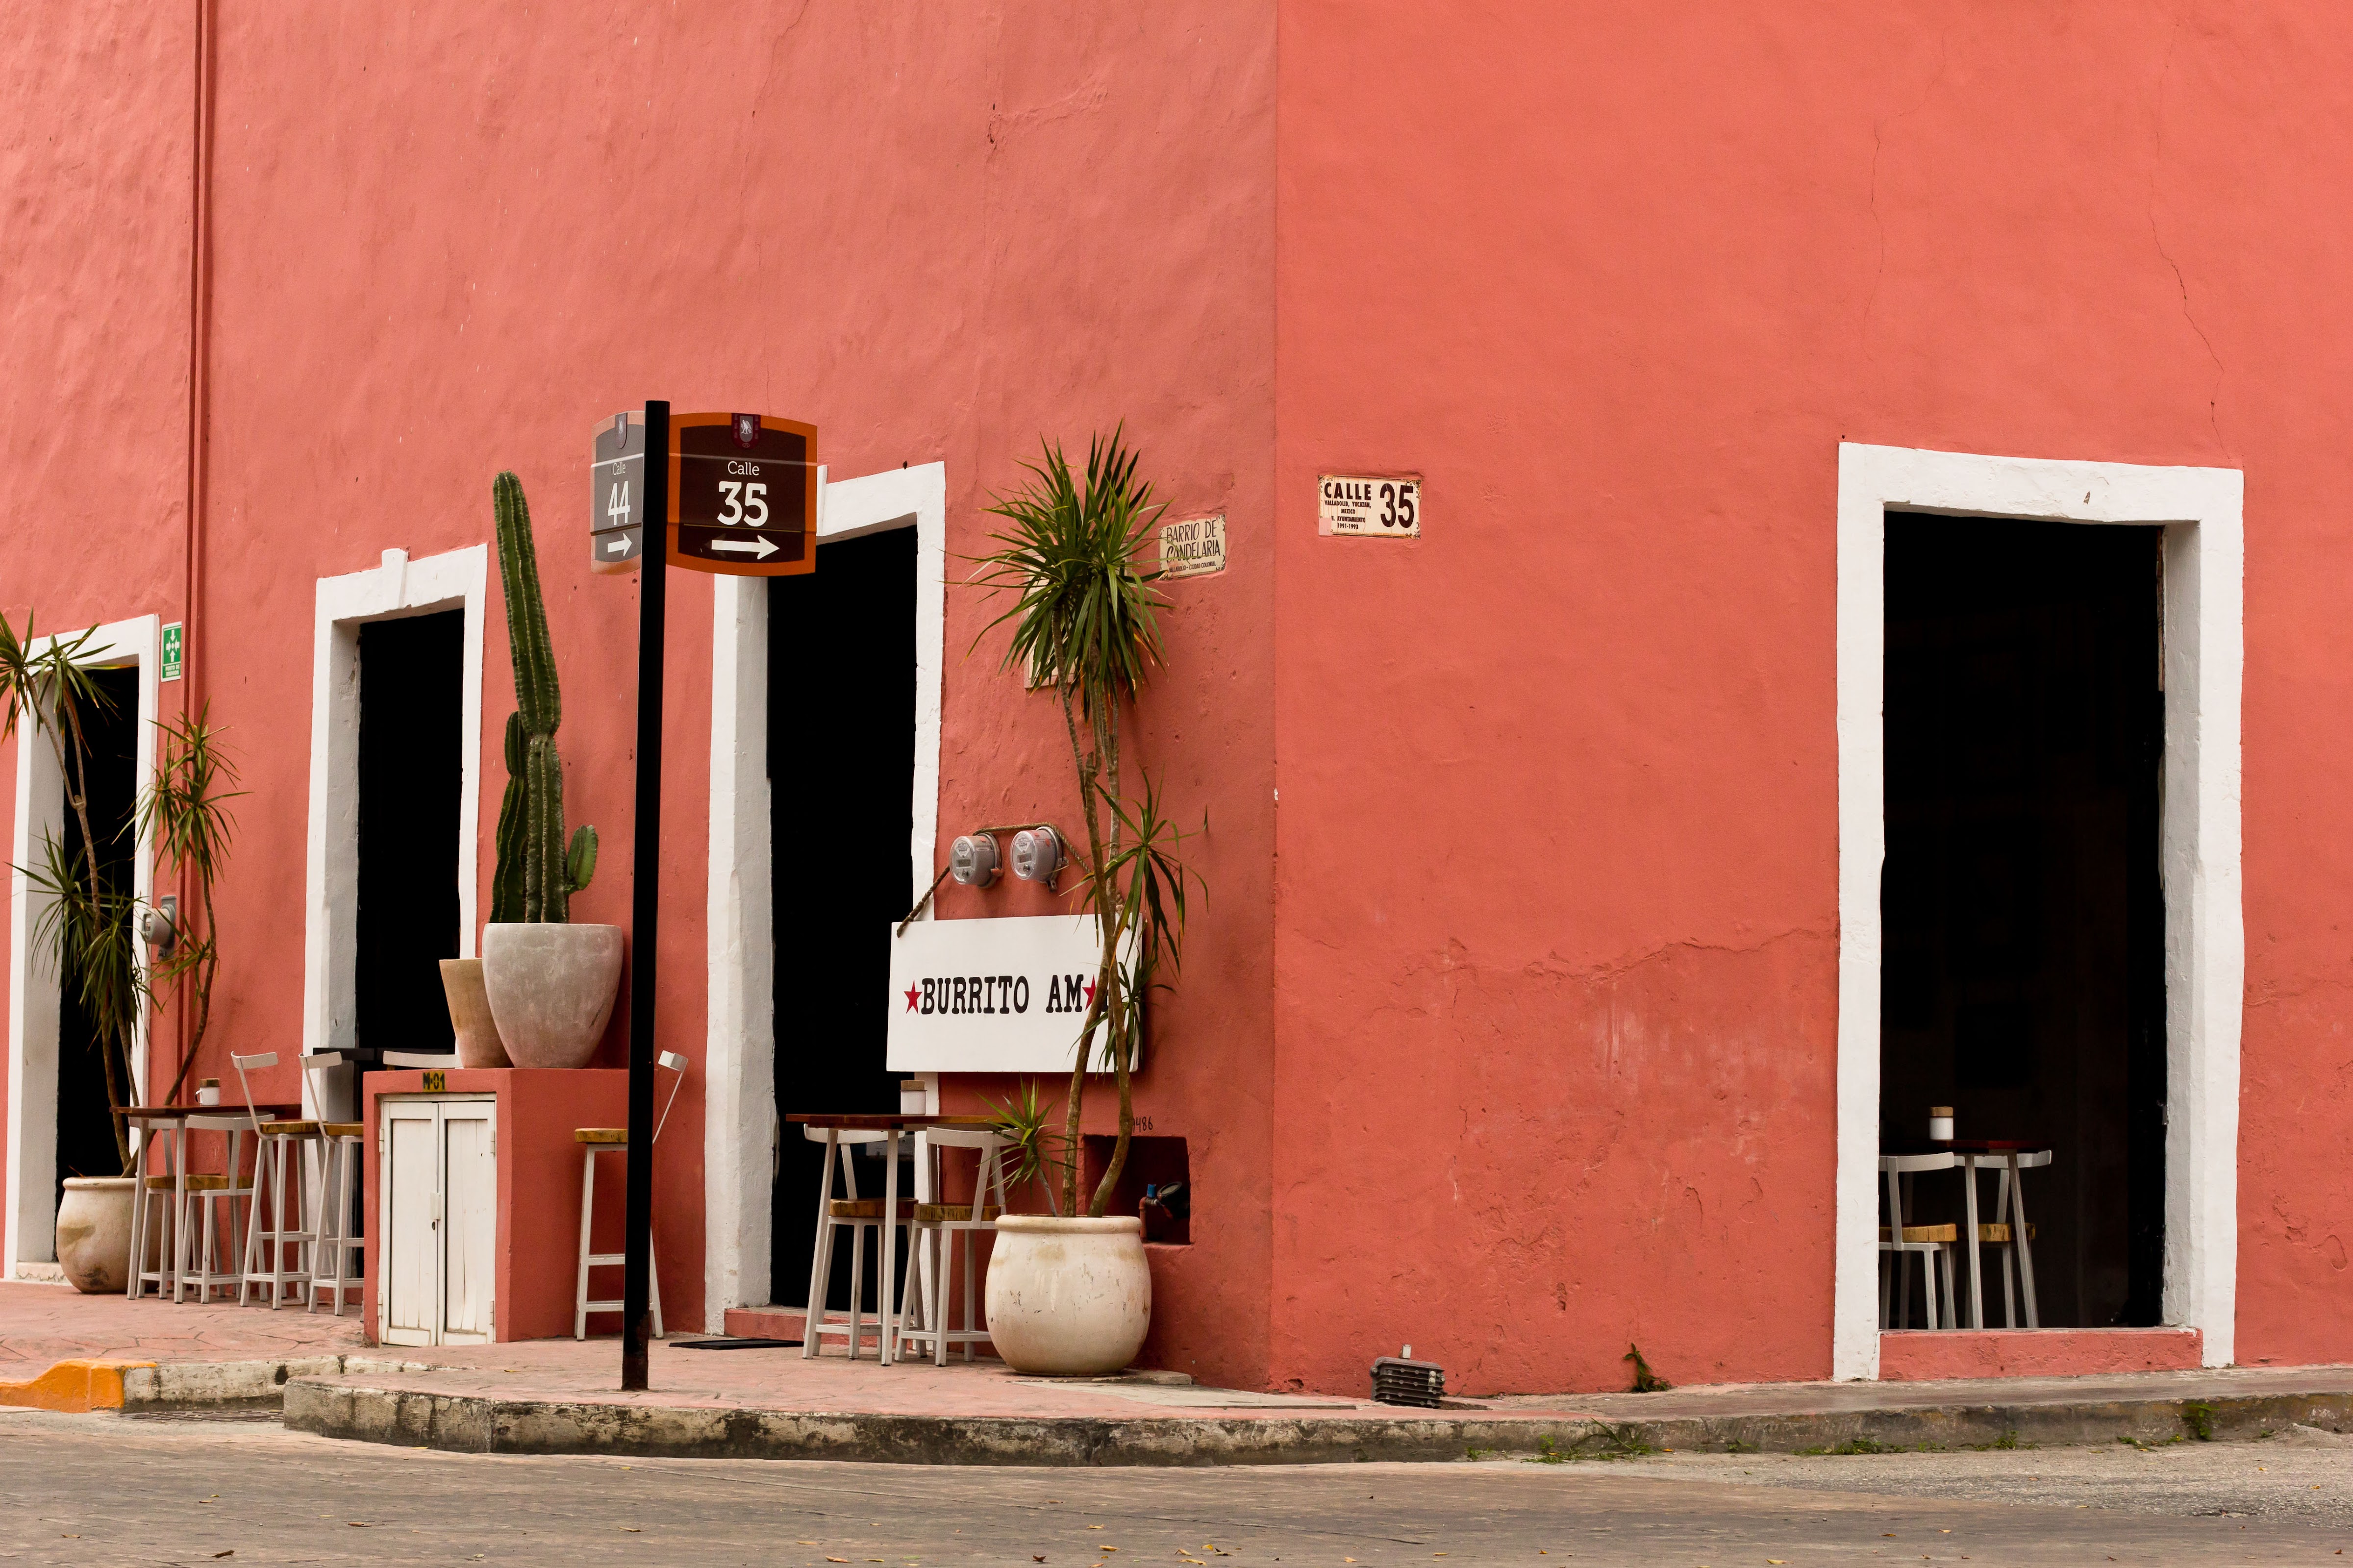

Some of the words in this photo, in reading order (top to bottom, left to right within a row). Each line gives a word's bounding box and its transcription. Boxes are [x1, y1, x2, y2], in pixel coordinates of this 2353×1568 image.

[613, 461, 626, 475] Calle
[727, 461, 760, 476] Calle
[608, 480, 630, 525] 44
[717, 481, 769, 527] 35
[1324, 482, 1371, 500] CALLE
[1380, 483, 1414, 528] 35
[1167, 523, 1200, 544] BARRIO
[1204, 520, 1217, 539] DE
[1167, 539, 1221, 563] CANDELARIA
[921, 975, 1029, 1015] BURRITO
